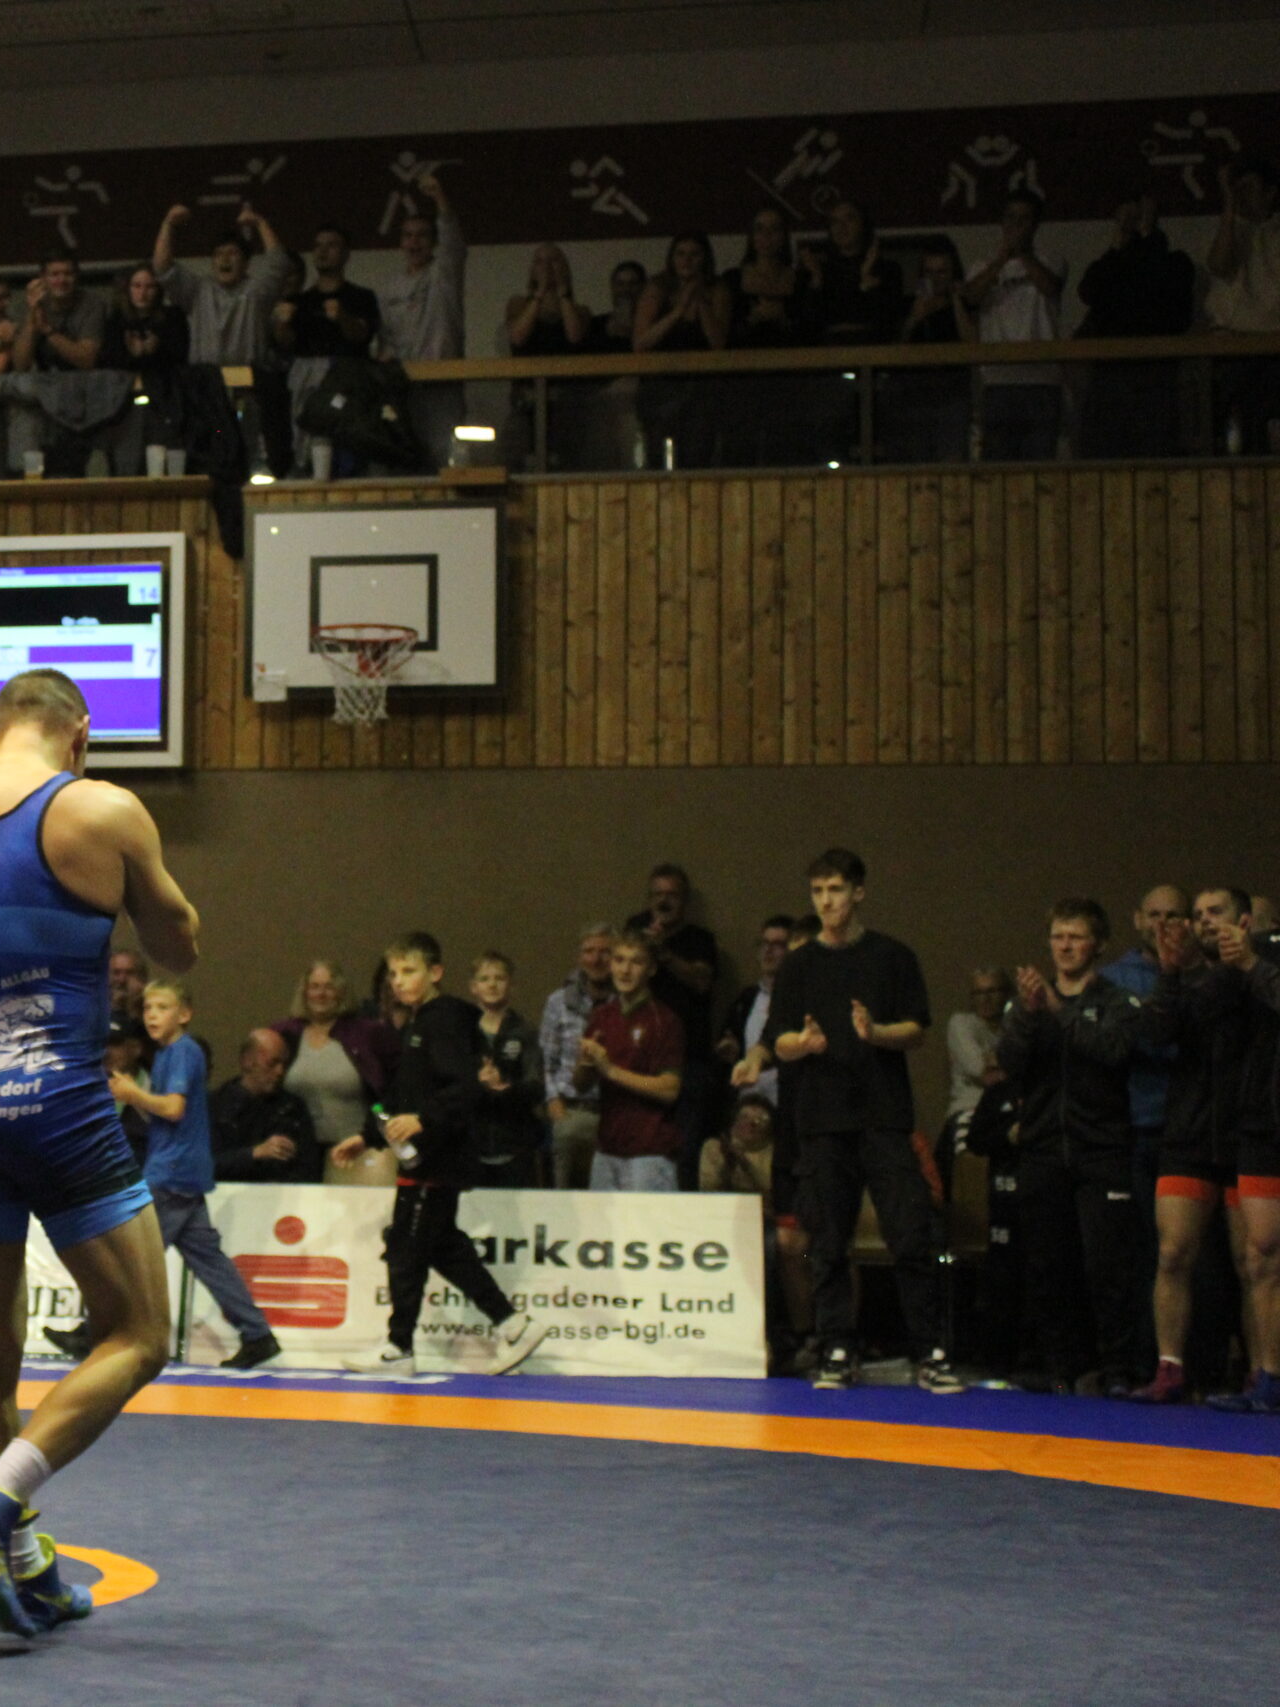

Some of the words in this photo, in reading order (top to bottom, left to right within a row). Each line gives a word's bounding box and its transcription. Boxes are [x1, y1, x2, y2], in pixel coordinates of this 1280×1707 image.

[380, 1223, 730, 1272] arkasse
[375, 1285, 645, 1312] Bchgadener
[660, 1292, 735, 1314] Land
[421, 1320, 707, 1345] ww.sasse-bgl.de
